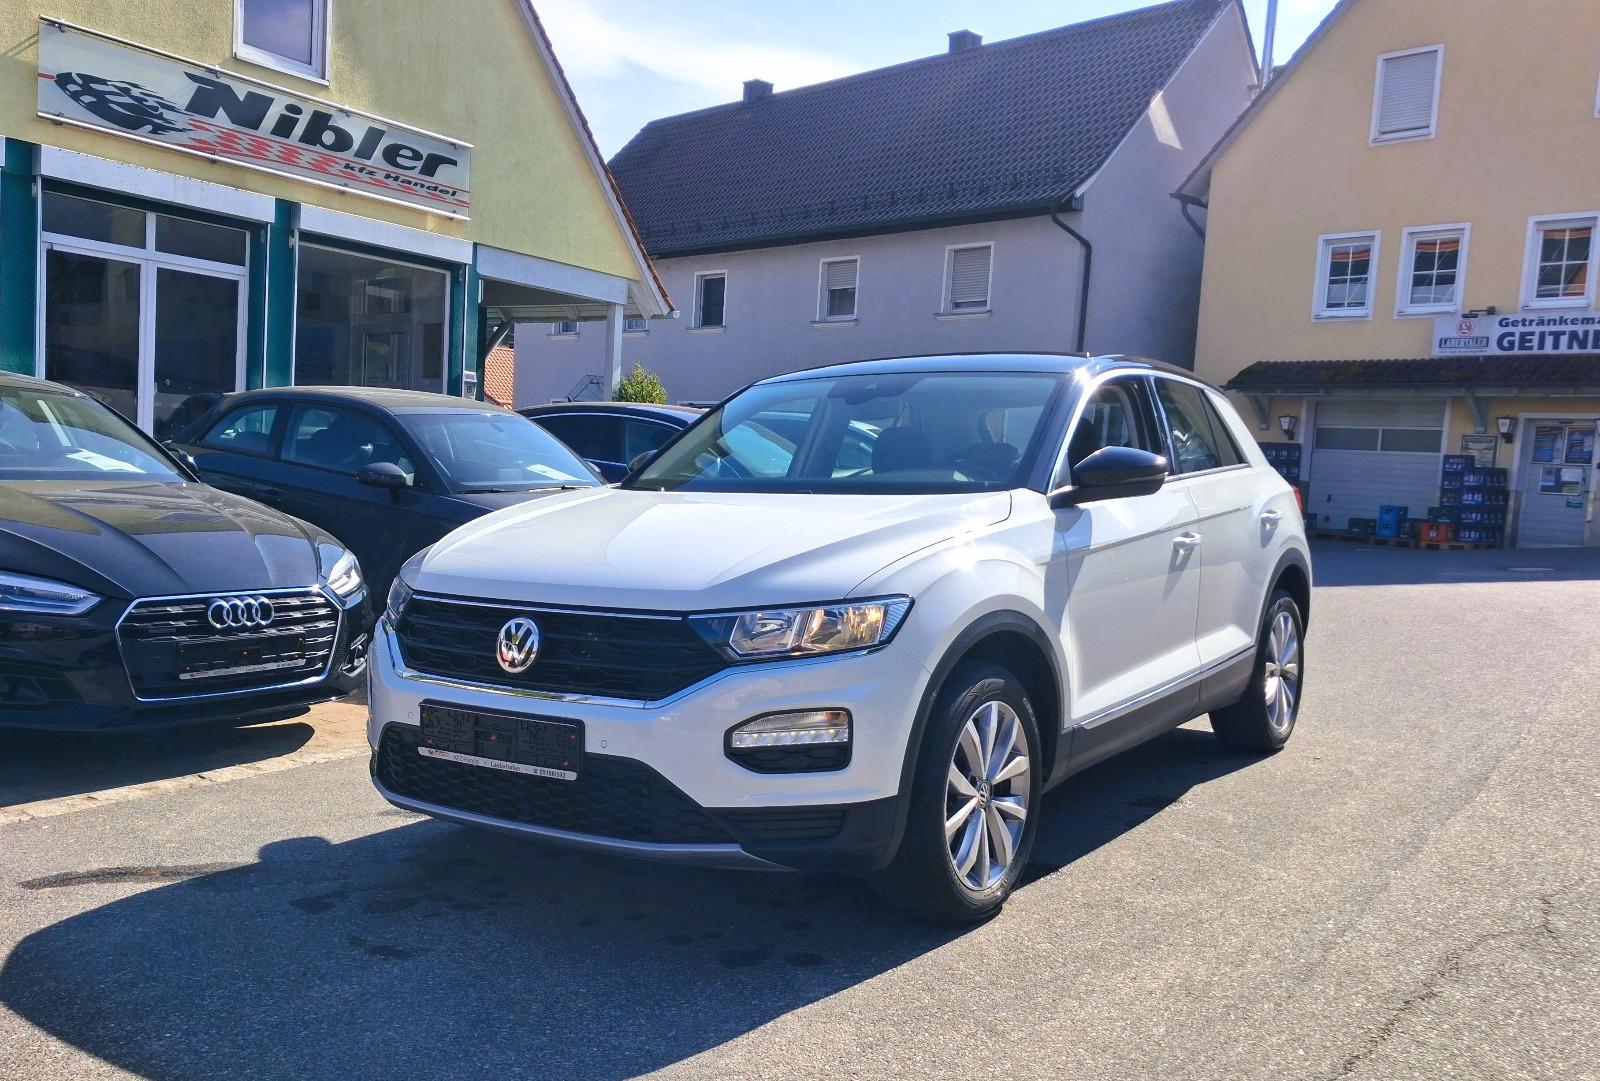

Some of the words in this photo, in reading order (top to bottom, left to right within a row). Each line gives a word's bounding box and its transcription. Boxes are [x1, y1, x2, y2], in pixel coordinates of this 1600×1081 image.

[184, 71, 458, 178] Nibler
[343, 162, 377, 176] kfz
[384, 173, 457, 197] Handel
